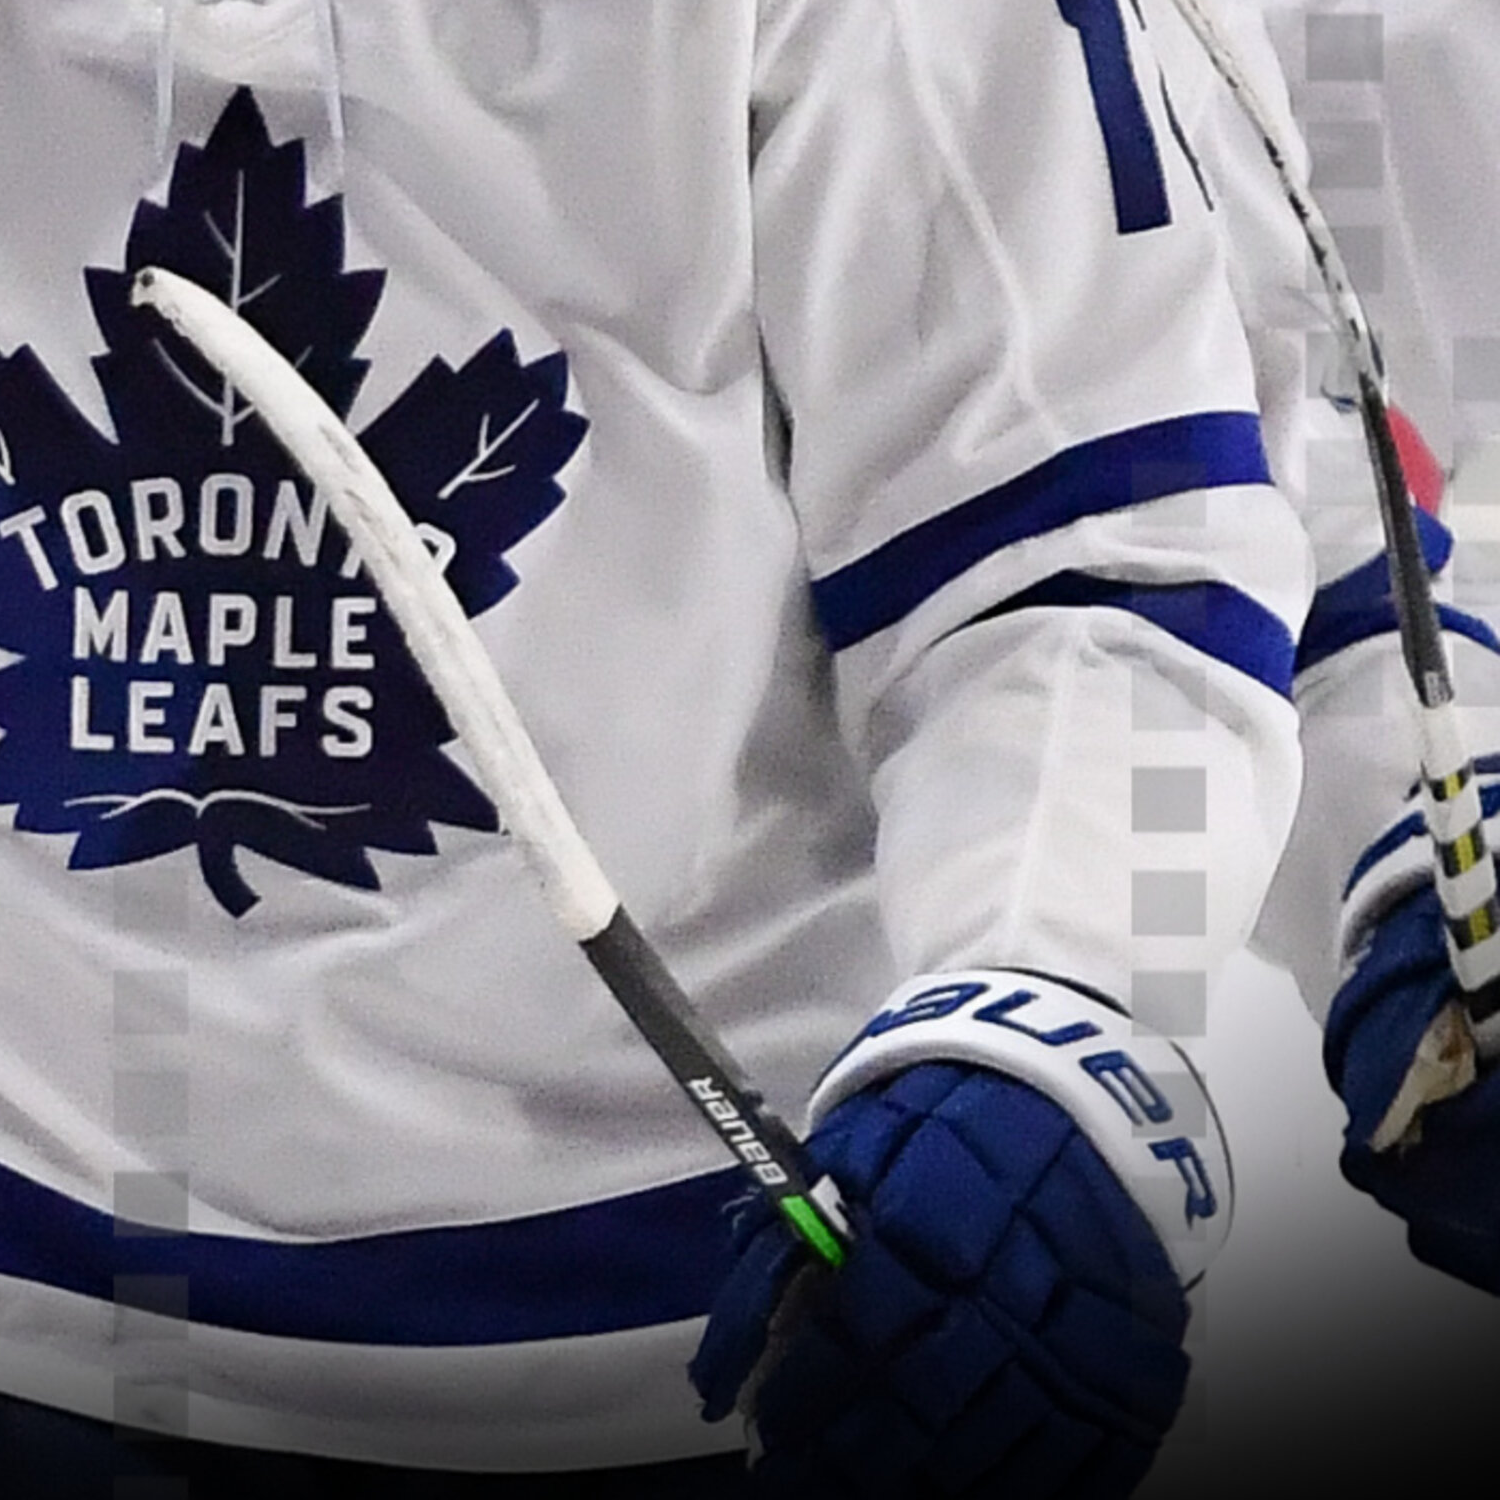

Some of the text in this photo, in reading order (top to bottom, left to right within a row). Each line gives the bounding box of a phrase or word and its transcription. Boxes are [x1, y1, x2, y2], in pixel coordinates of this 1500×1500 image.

[73, 586, 376, 670] MAPLE
[70, 675, 373, 758] LEAFS
[810, 982, 1218, 1230] AUER
